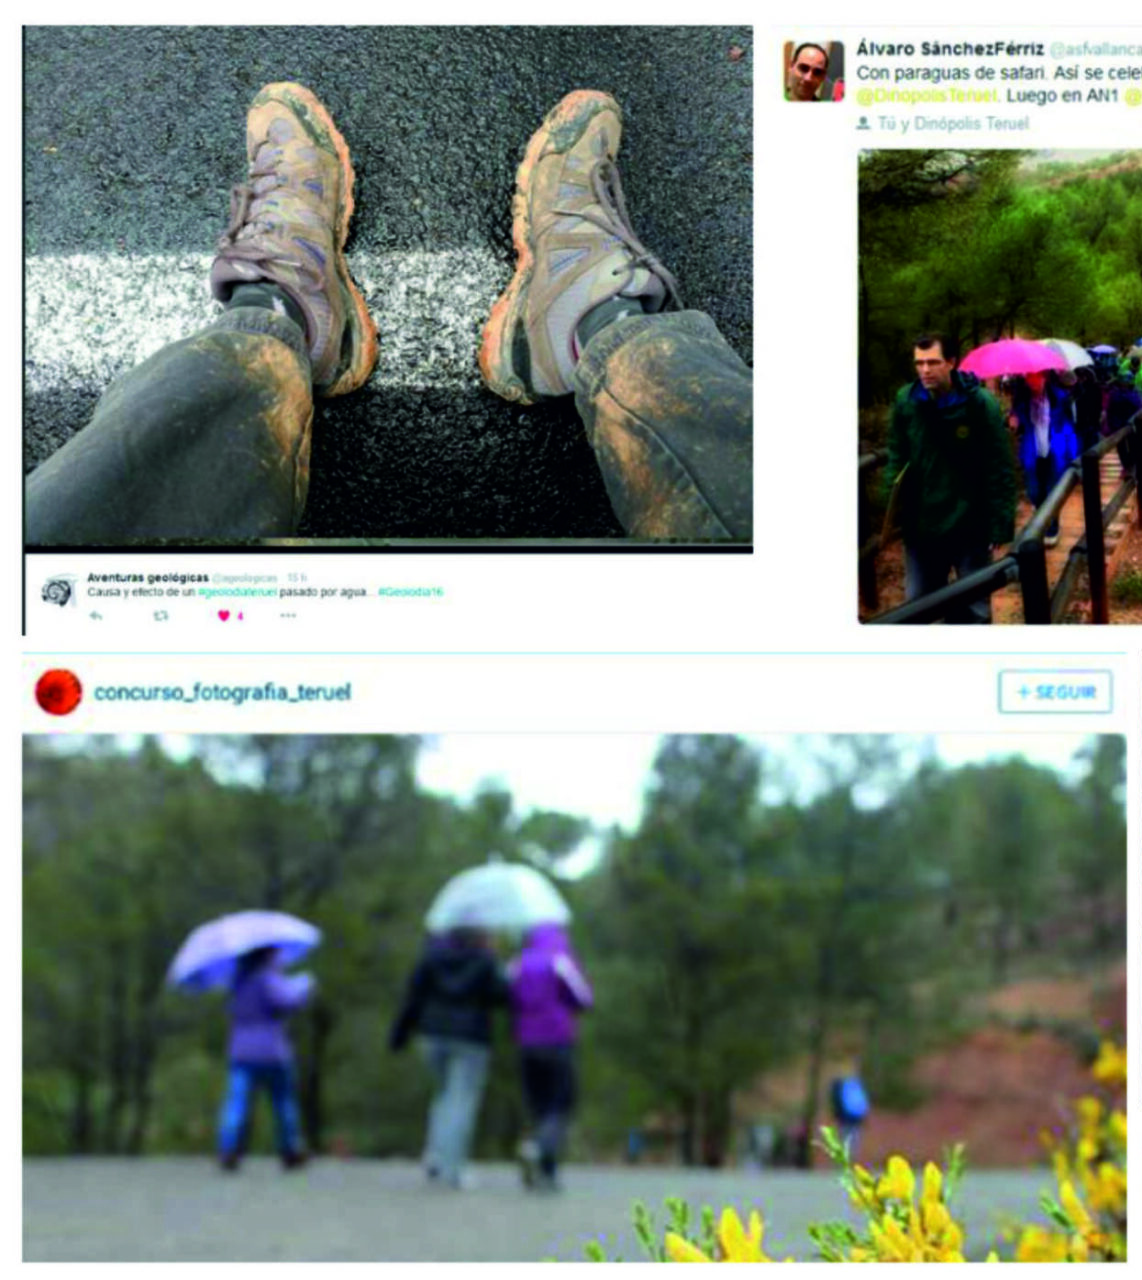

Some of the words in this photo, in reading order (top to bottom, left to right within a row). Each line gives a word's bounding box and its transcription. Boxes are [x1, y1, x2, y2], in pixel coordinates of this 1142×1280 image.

[857, 37, 915, 57] Álvaro
[921, 40, 1046, 57] SánchezFérriz
[857, 65, 889, 80] Con
[894, 67, 970, 84] paraguas
[975, 65, 995, 80] de
[1000, 65, 1049, 81] safari.
[1054, 64, 1079, 80] Así
[1085, 68, 1104, 80] se
[1006, 88, 1058, 106] Luego
[1062, 90, 1082, 103] en
[1086, 88, 1118, 103] AN1
[878, 115, 896, 130] Tú
[901, 120, 910, 133] y
[915, 115, 982, 133] Dinópolis
[986, 115, 1030, 130] Teruel
[87, 573, 144, 583] Aventuras
[147, 572, 209, 584] geológicas
[87, 587, 121, 597] Causa
[123, 589, 130, 599] y
[132, 587, 164, 597] efecto
[166, 587, 180, 597] de
[182, 589, 196, 597] un
[279, 587, 318, 599] pasado
[320, 589, 338, 599] por
[94, 681, 352, 706] concurso_fotografia_teruel
[1036, 685, 1097, 699] SEGUIR
